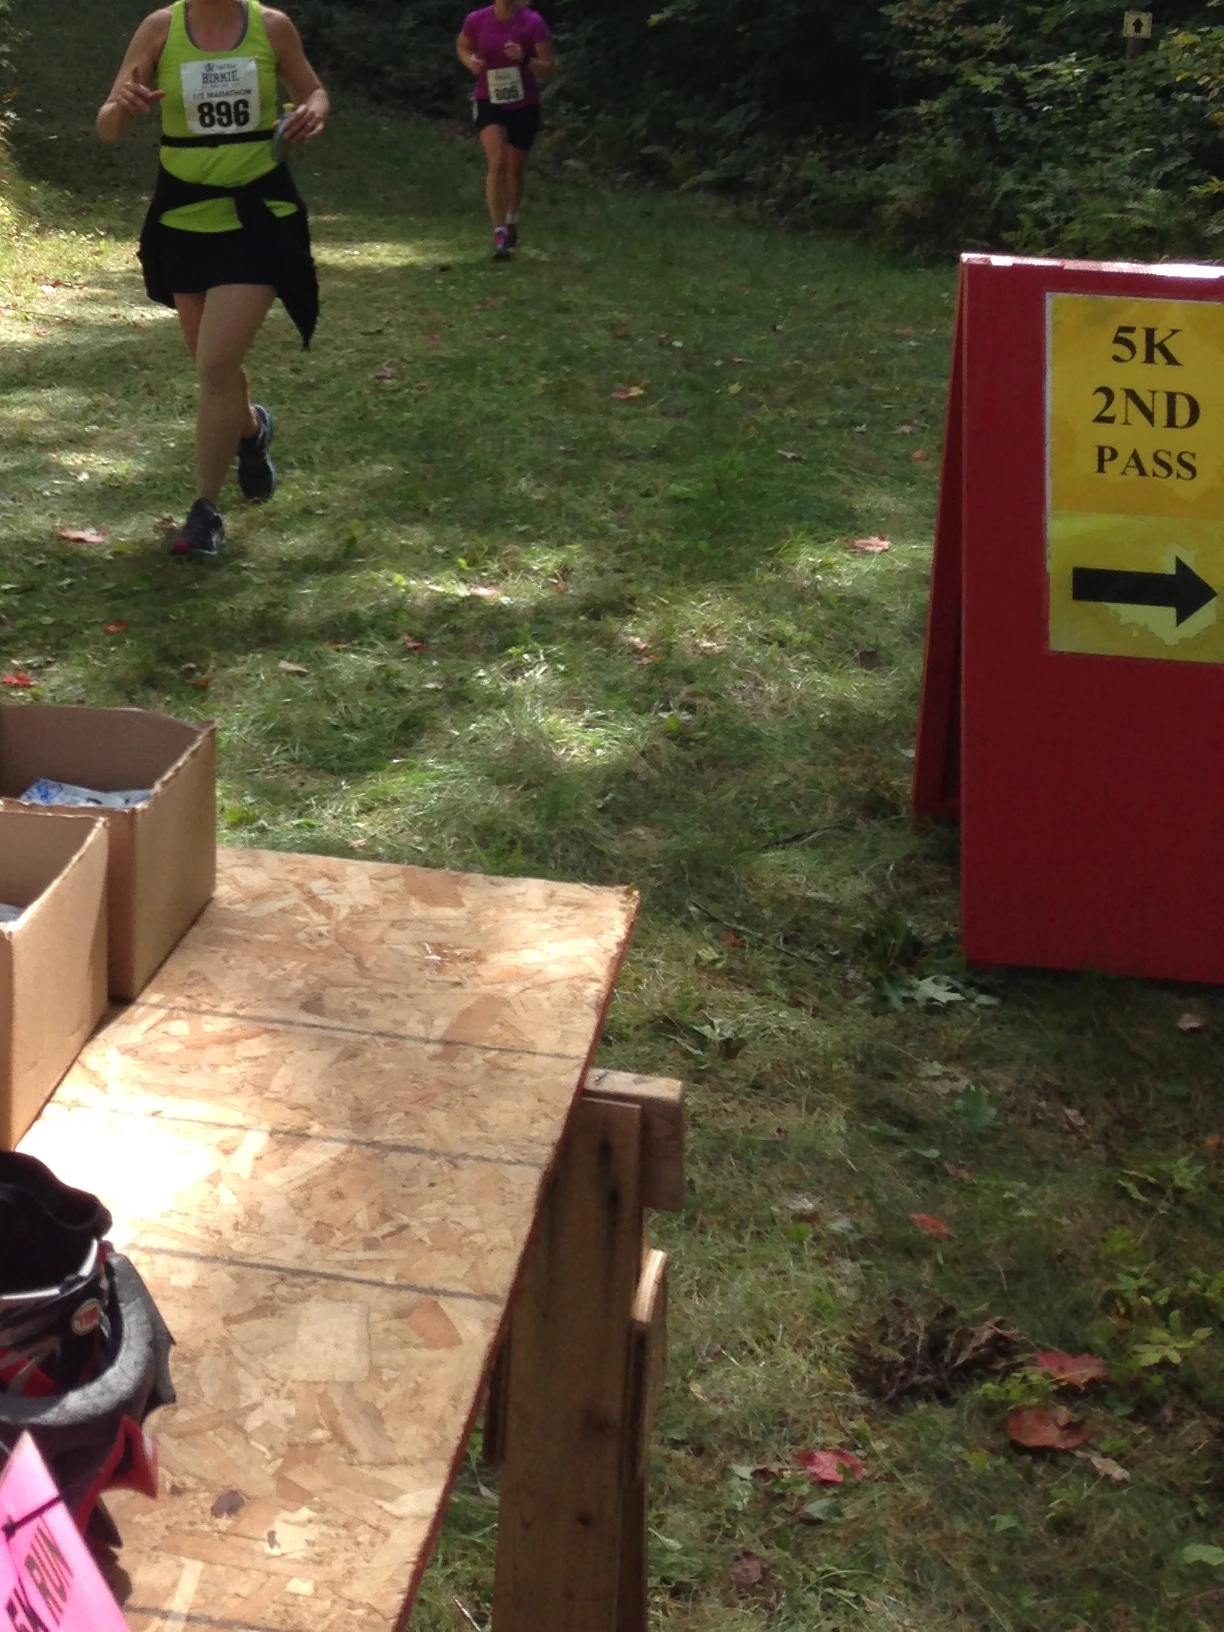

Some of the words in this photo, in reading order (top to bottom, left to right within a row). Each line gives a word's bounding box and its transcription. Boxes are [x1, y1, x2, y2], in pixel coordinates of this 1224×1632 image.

[197, 99, 250, 128] 896
[207, 89, 252, 99] MARATHON
[1111, 325, 1183, 367] 5K
[1091, 385, 1201, 430] 2ND
[1095, 444, 1198, 481] PASS
[24, 1524, 74, 1627] RUN
